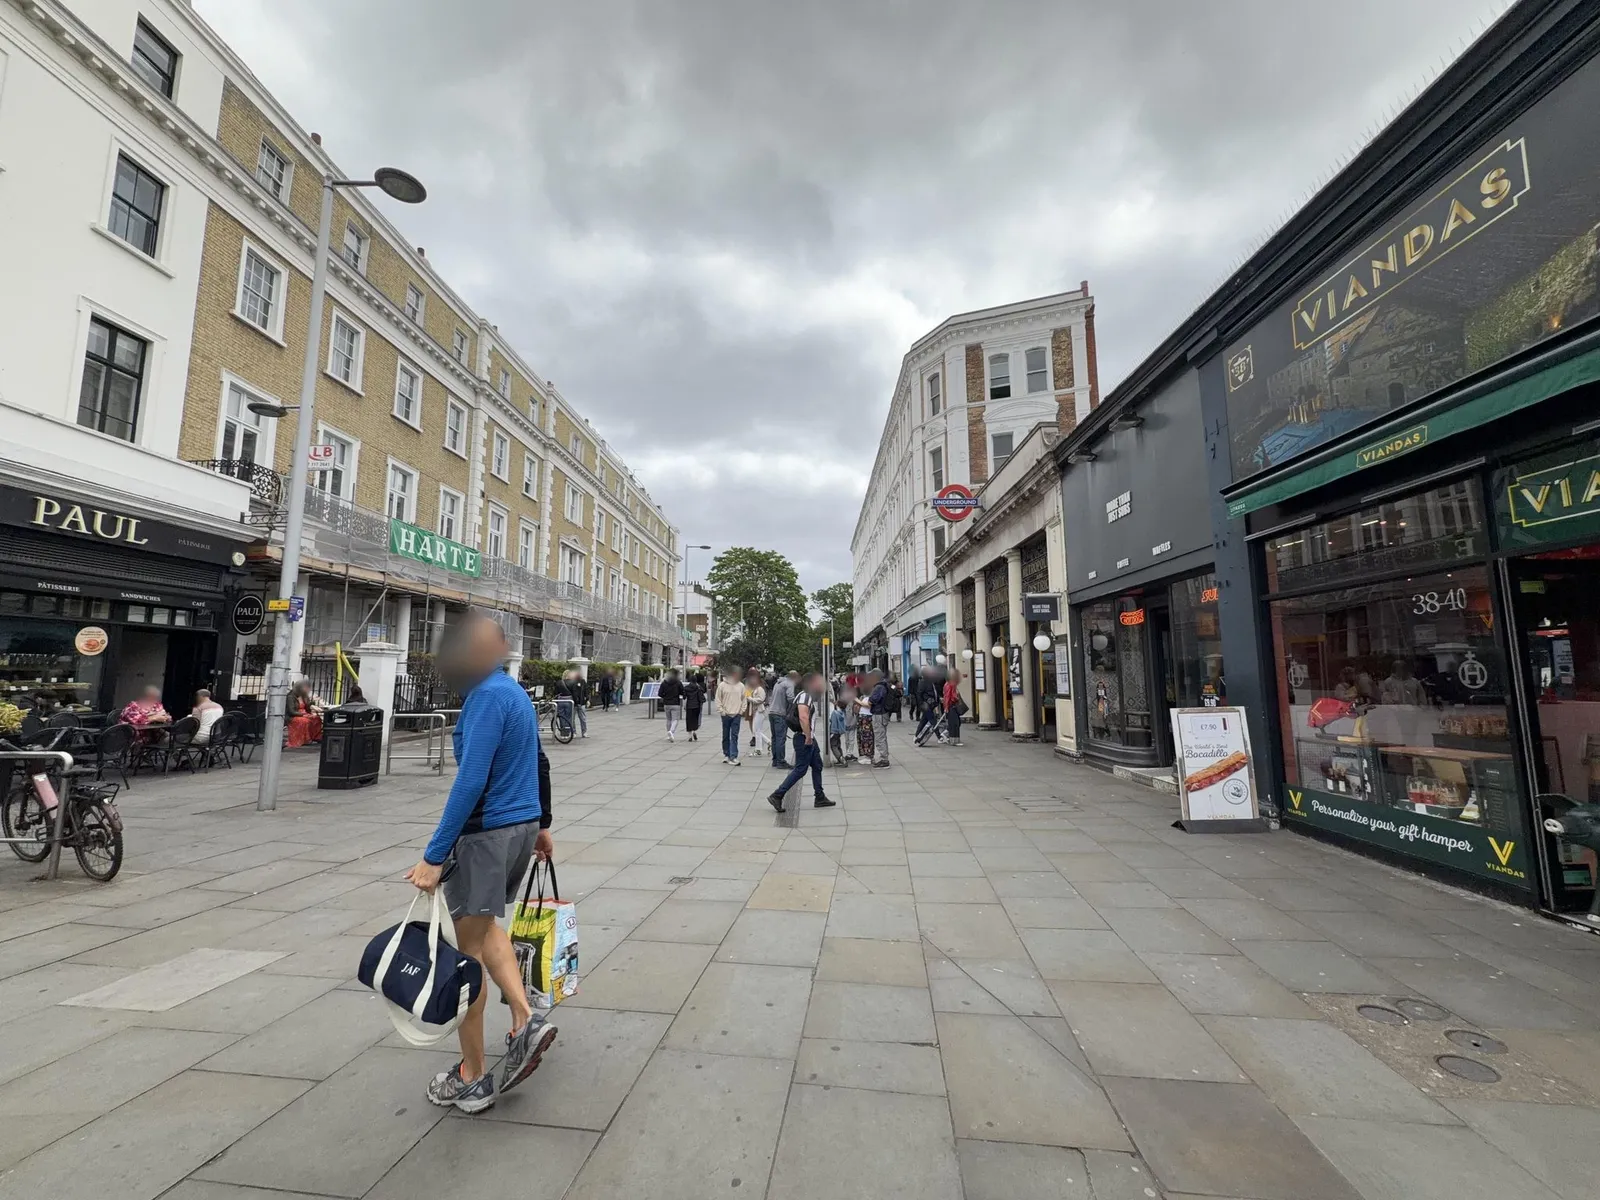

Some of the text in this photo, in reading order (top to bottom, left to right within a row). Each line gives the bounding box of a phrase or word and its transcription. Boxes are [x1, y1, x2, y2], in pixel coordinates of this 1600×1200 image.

[1301, 168, 1511, 332] VIANDAS
[1363, 432, 1421, 462] VIANDAS
[30, 496, 149, 545] PAUL
[399, 527, 477, 572] HARTE
[37, 582, 80, 593] PÂTISSERIE
[121, 592, 161, 602] SANDWICHES
[1412, 588, 1467, 615] 38-40
[237, 607, 260, 616] PAUL
[1185, 748, 1228, 758] Bocadillo
[1287, 808, 1308, 817] VIANDAS
[1311, 800, 1474, 853] Personalize your gift hamper
[1485, 861, 1525, 879] VIANDAS
[401, 962, 421, 977] JAF
